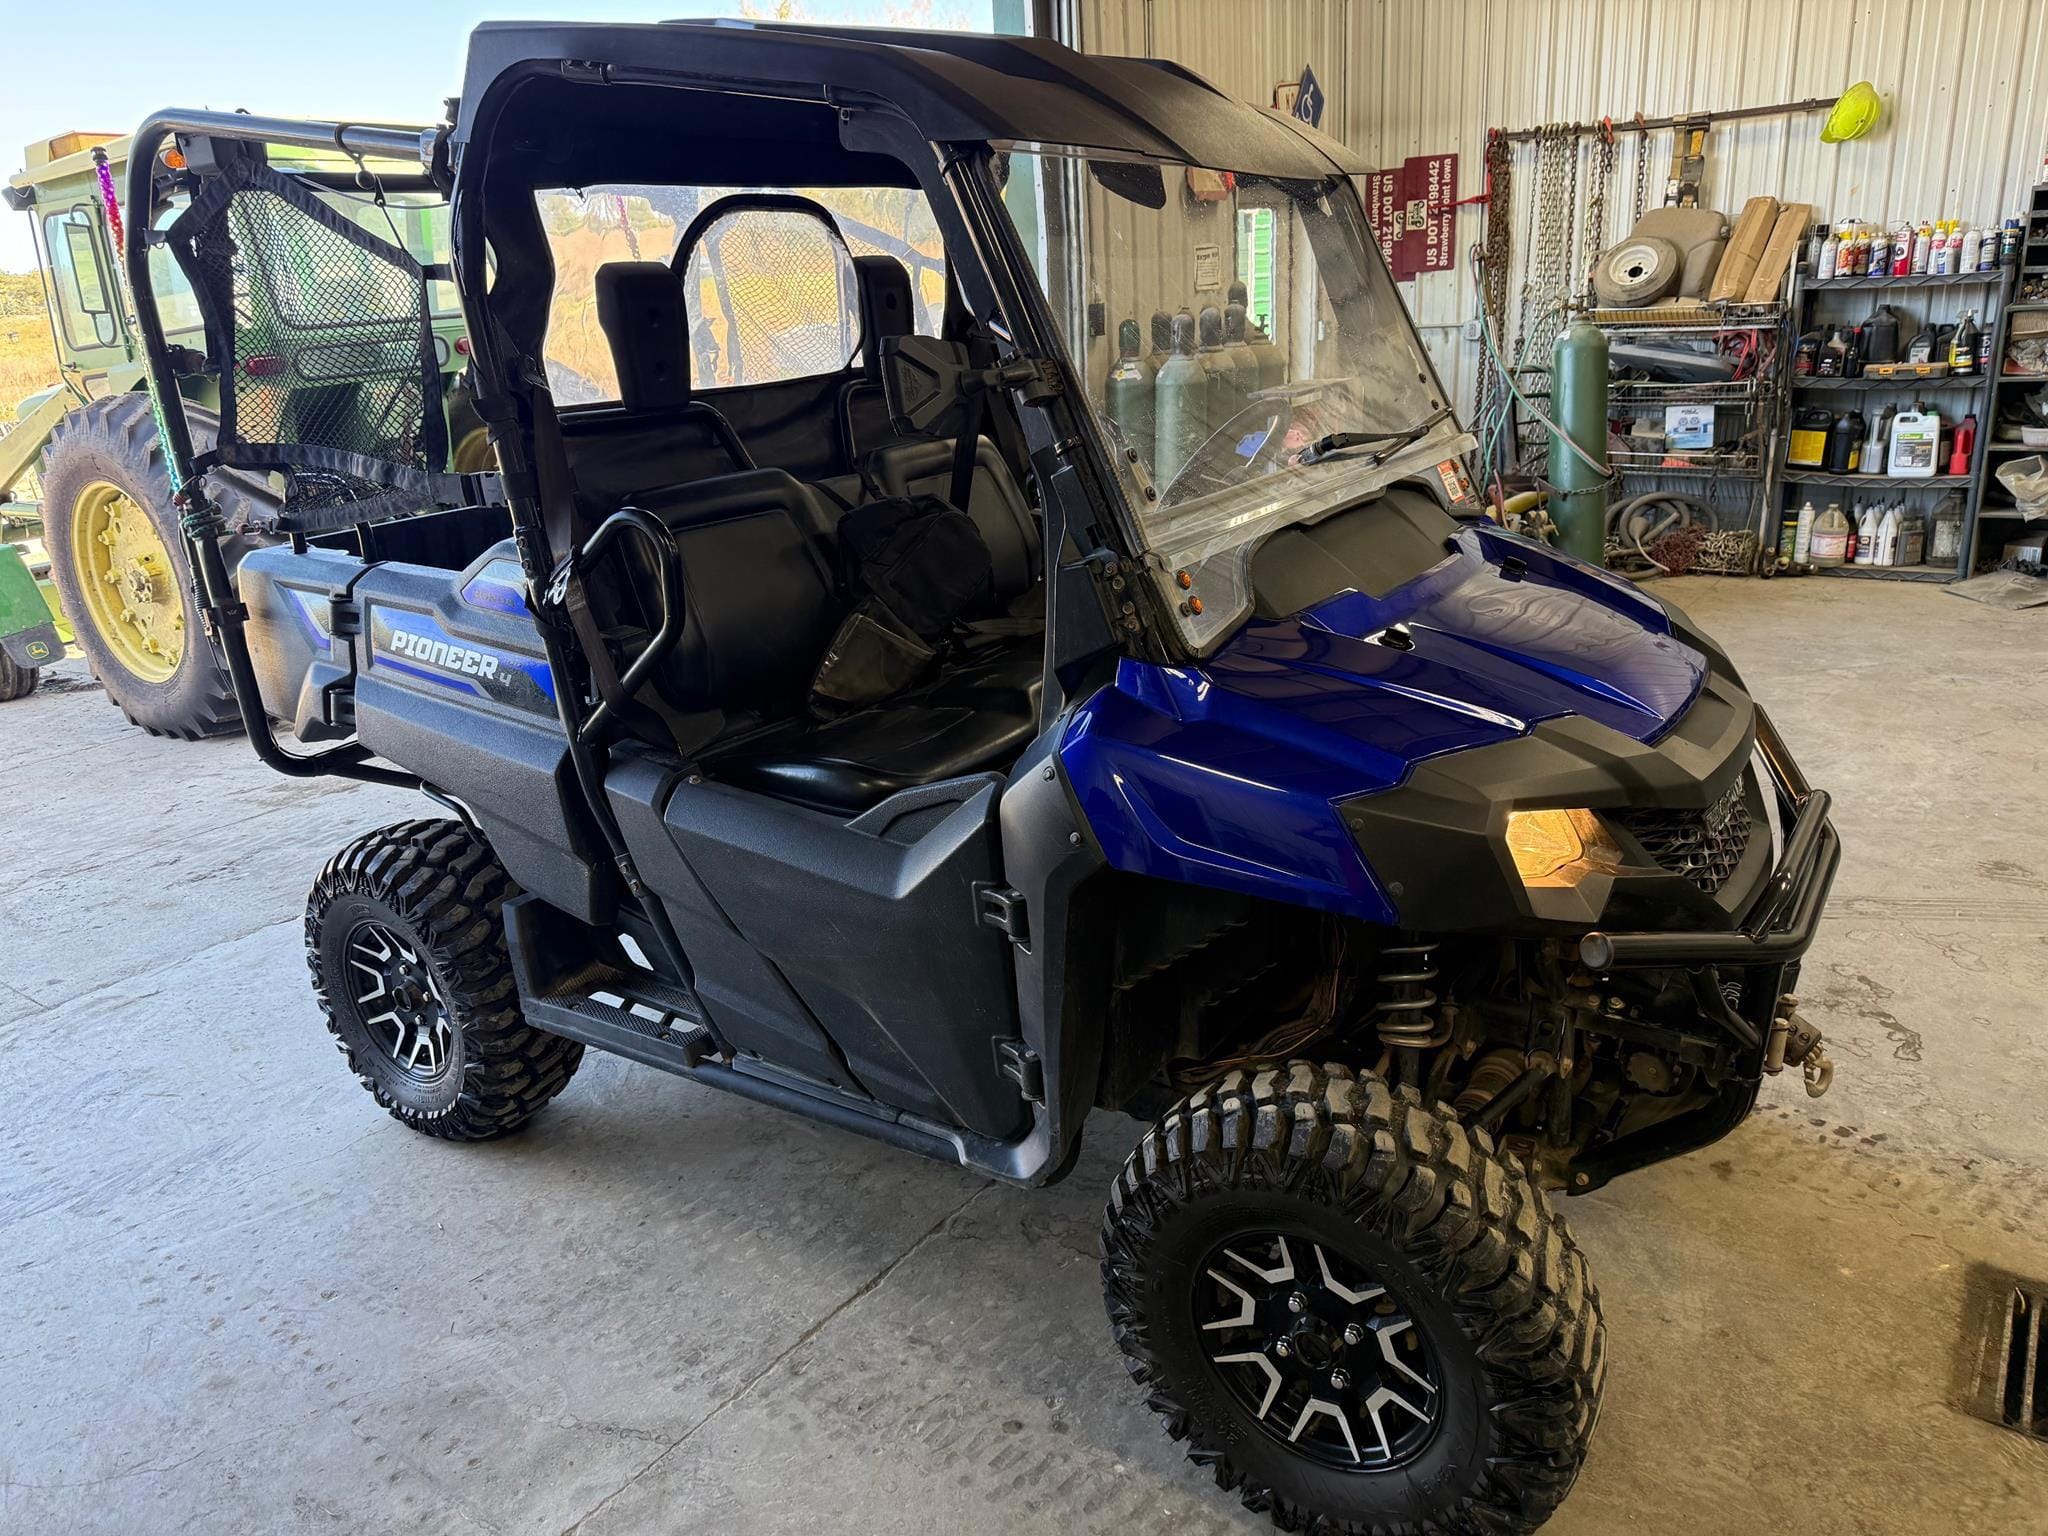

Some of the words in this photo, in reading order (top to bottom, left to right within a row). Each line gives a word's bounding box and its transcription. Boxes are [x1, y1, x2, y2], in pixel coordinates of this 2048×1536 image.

[1383, 175, 1394, 193] US
[1442, 158, 1452, 183] Iowa
[1428, 160, 1440, 215] 2198442
[1370, 175, 1381, 228] Strawberry
[1383, 196, 1393, 223] DOT
[1427, 218, 1439, 245] DOT
[1439, 213, 1452, 266] Strawberry
[1427, 248, 1438, 266] US
[390, 629, 499, 680] PIONEER
